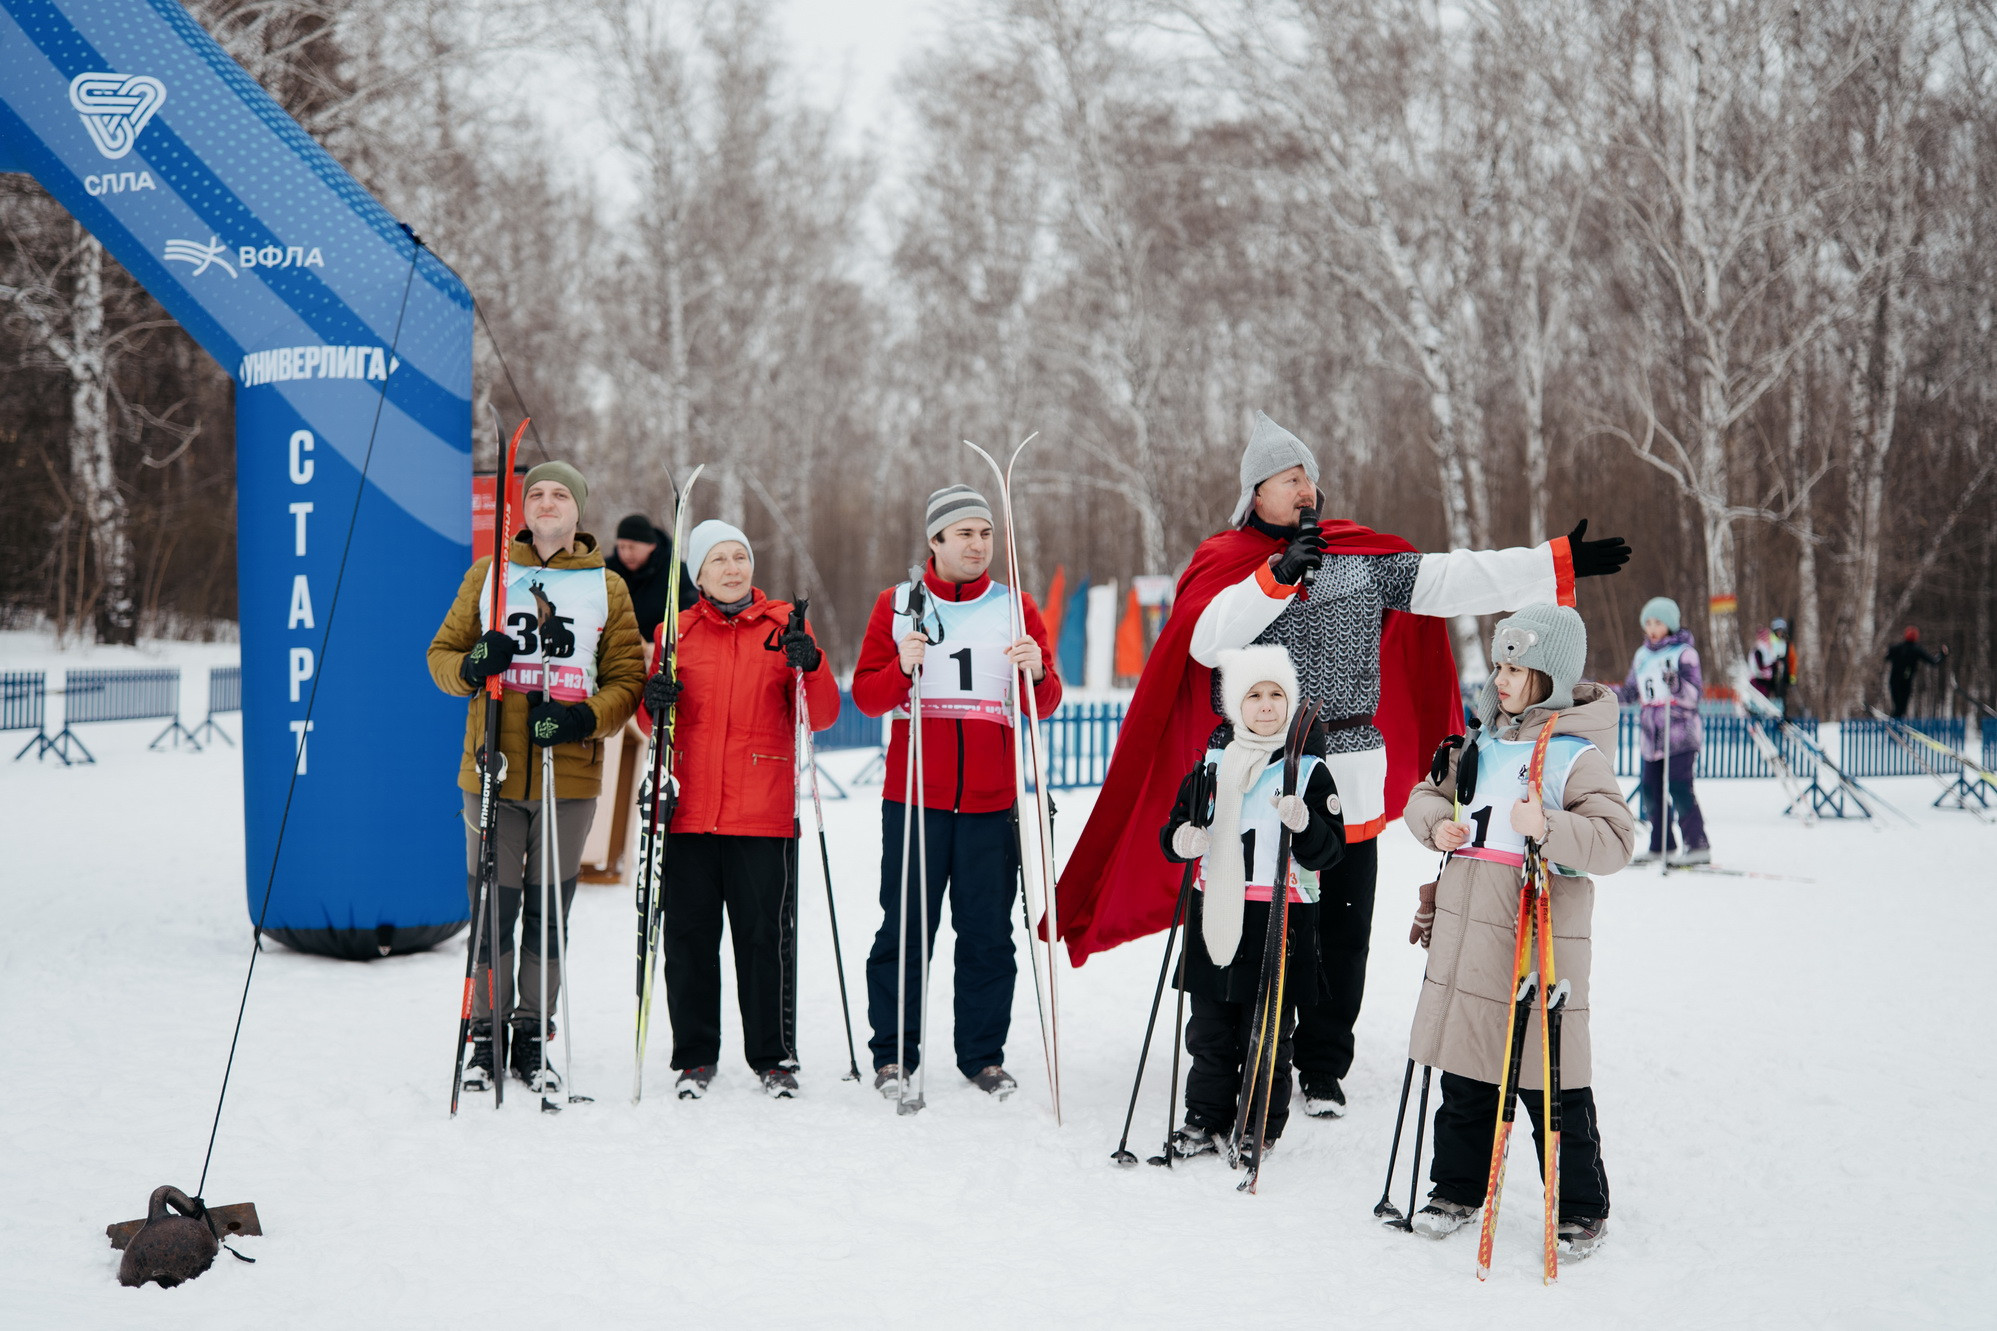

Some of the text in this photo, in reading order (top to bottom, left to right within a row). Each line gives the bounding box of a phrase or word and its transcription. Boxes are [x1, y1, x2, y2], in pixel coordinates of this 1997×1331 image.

[84, 171, 157, 197] СЛЛА
[239, 245, 325, 268] ВФЛА
[243, 345, 388, 388] УНИВЕРЛИГА
[502, 502, 512, 588] MADSHUS
[288, 429, 315, 775] СТАРТ
[949, 648, 973, 691] 1
[480, 772, 492, 828] MADSHUS
[1471, 805, 1493, 848] 1
